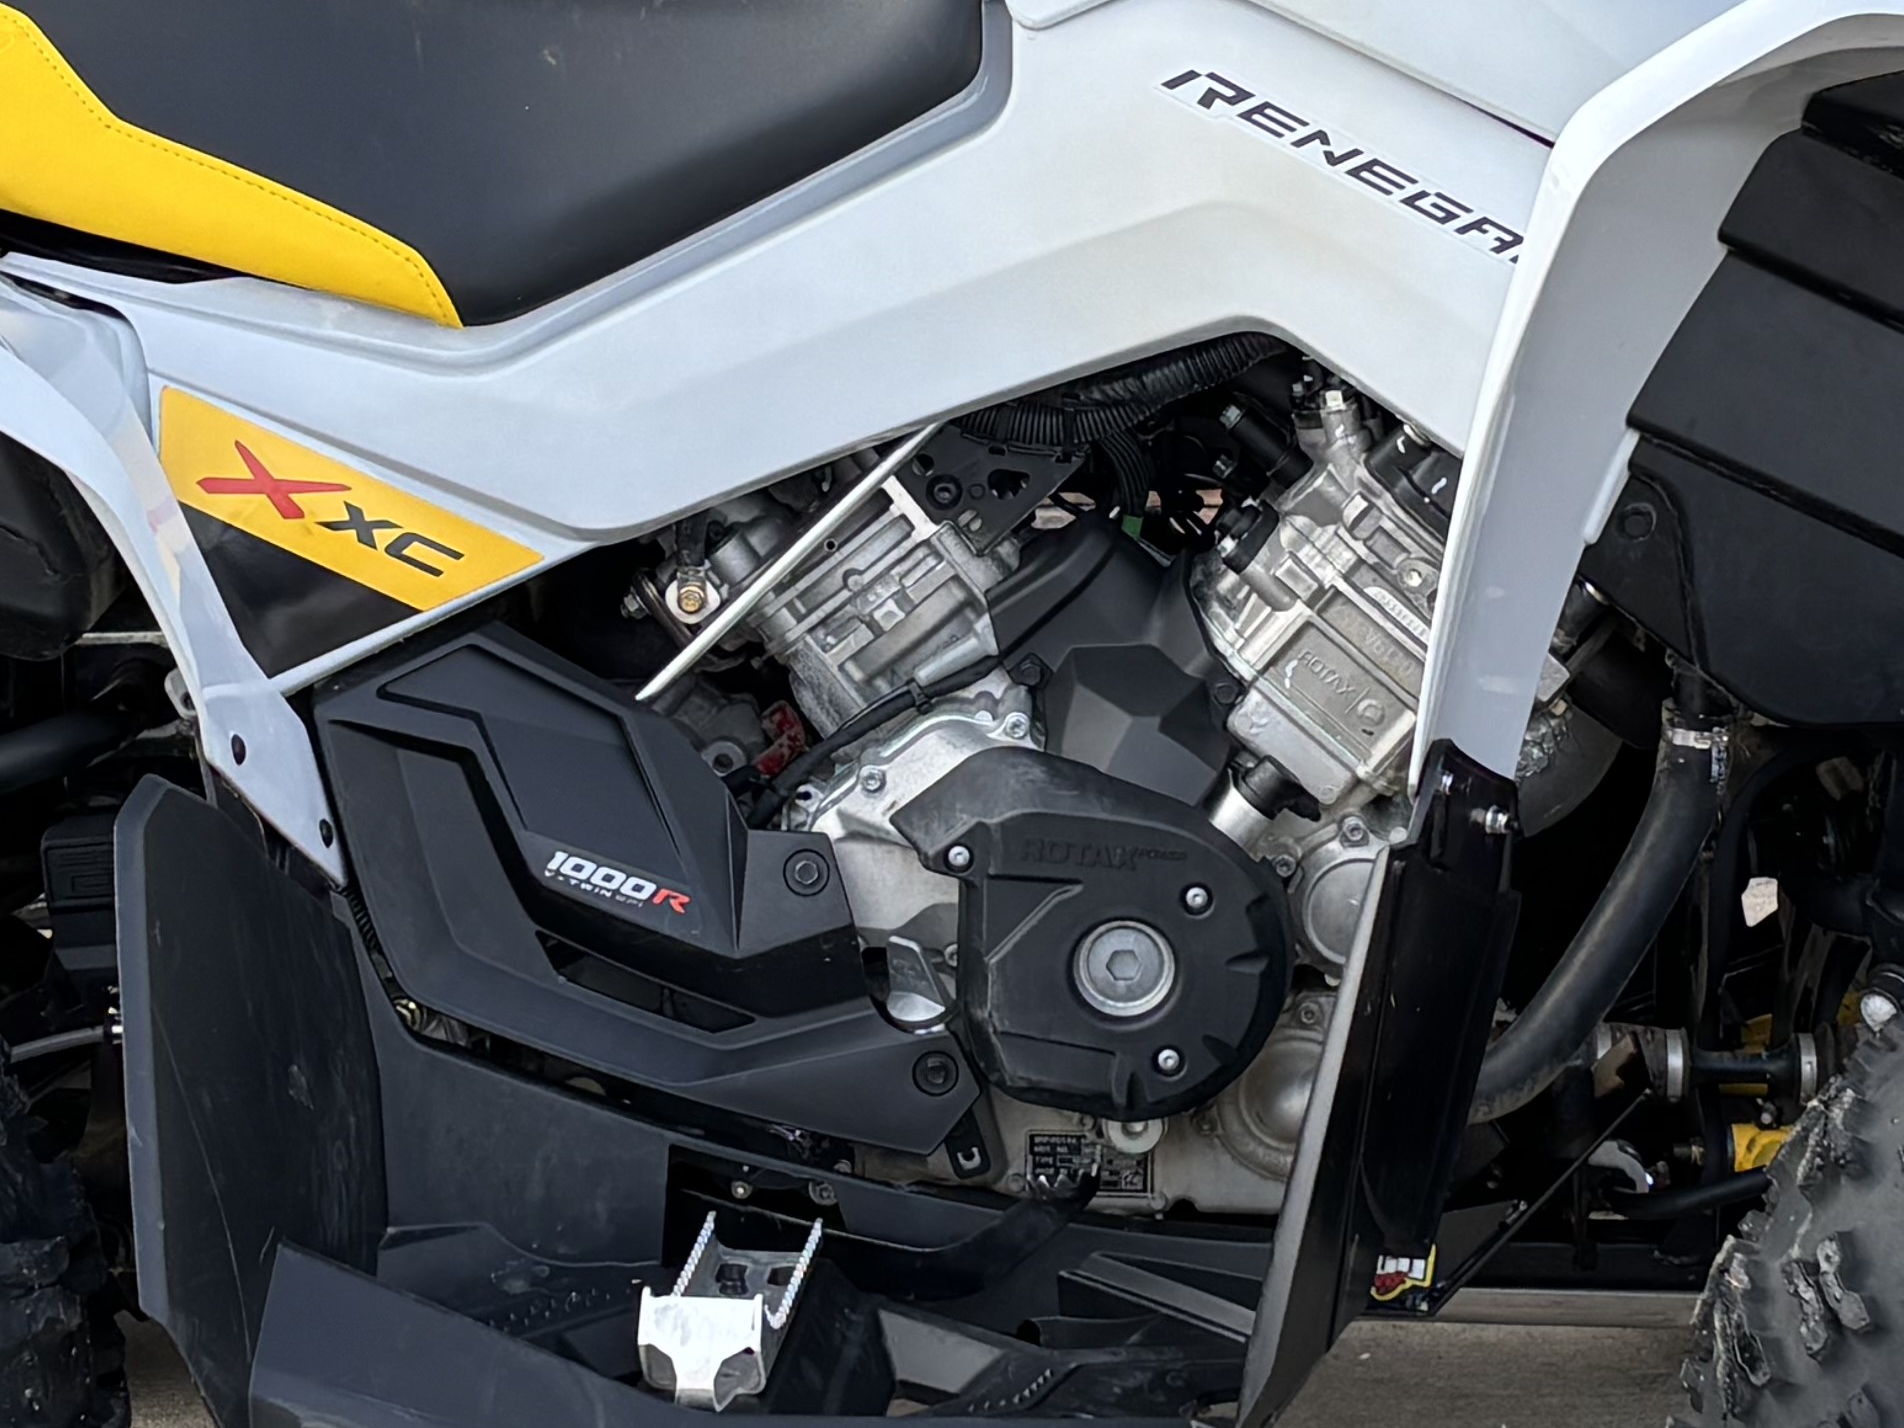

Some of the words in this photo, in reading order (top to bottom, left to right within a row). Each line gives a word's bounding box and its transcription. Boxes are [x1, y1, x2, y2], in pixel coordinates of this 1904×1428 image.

[1160, 69, 1525, 264] RENEGA
[196, 440, 352, 520] X
[316, 501, 465, 578] XC
[1298, 649, 1356, 698] ROTAX
[546, 850, 692, 914] 1000R
[1021, 838, 1138, 871] ROTAX
